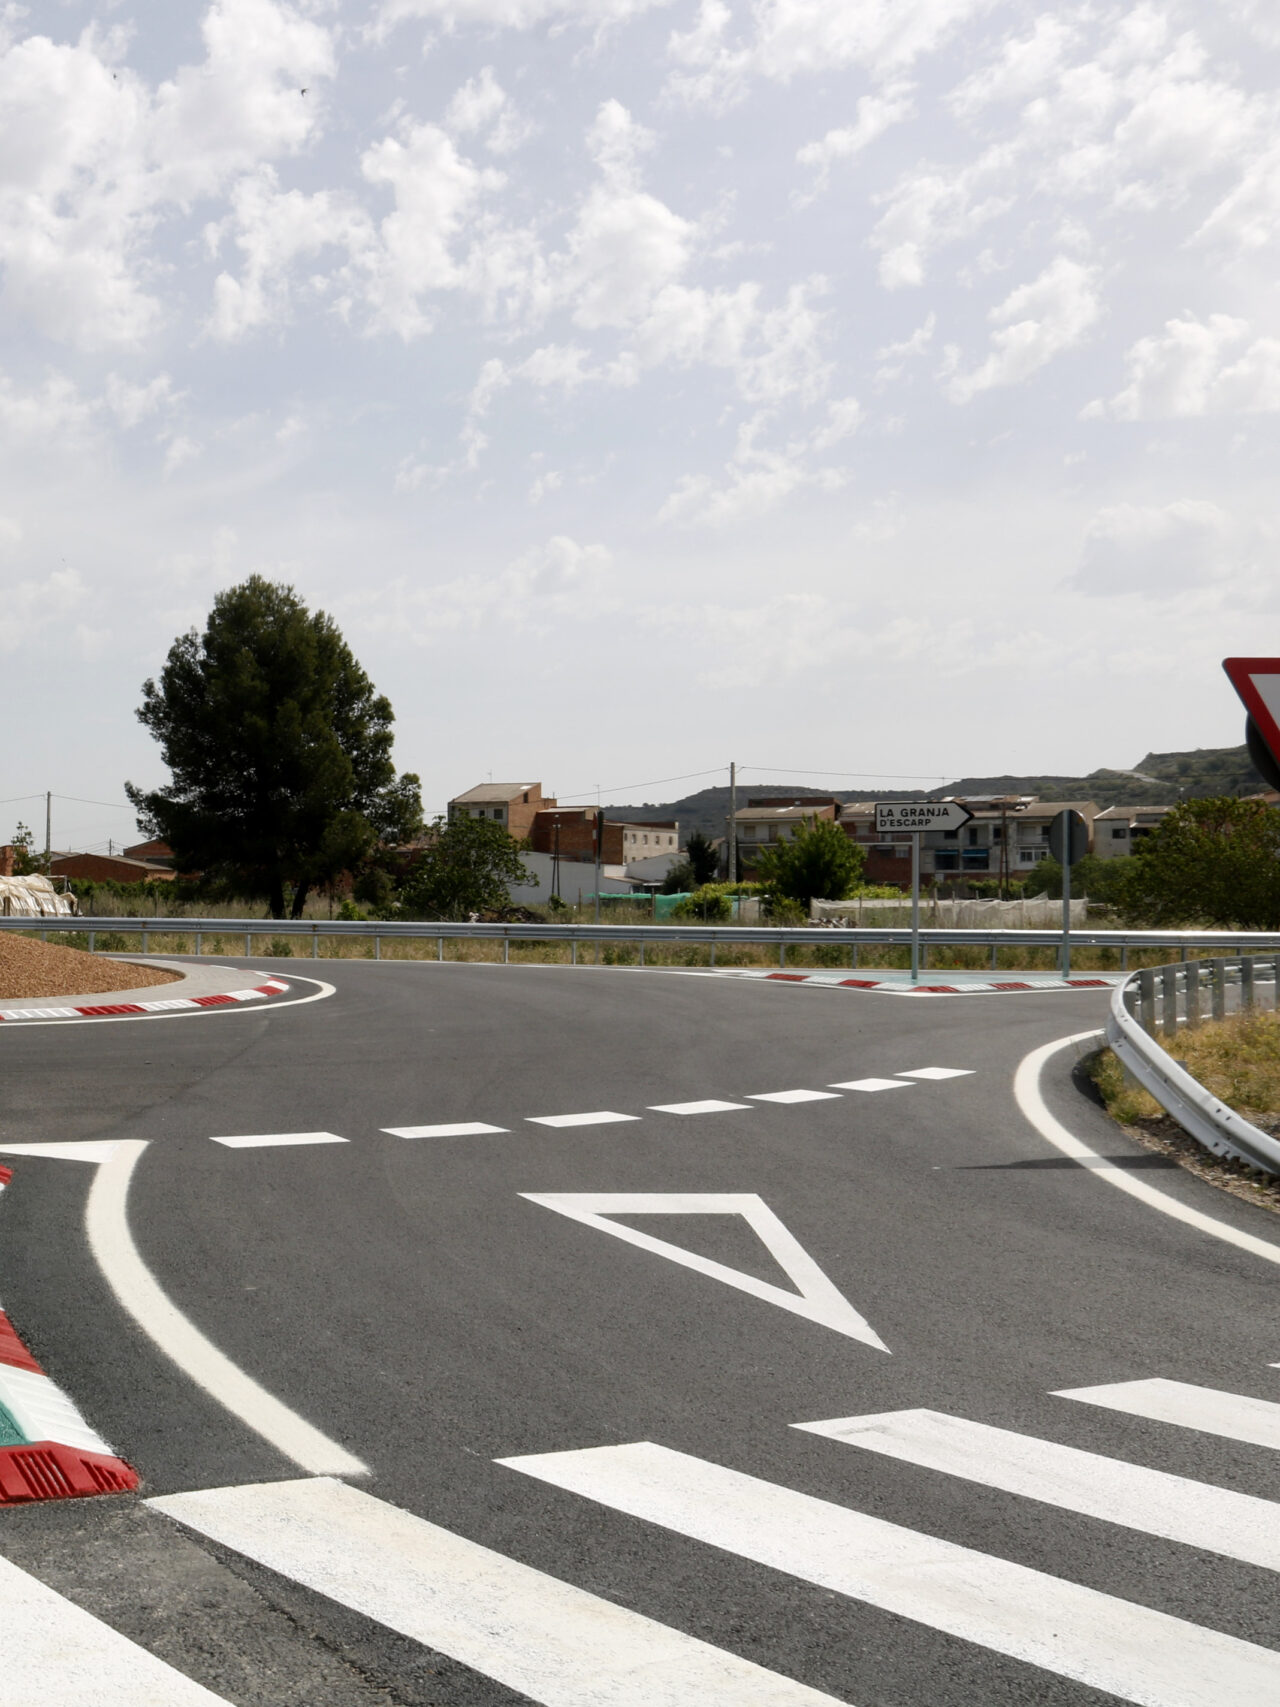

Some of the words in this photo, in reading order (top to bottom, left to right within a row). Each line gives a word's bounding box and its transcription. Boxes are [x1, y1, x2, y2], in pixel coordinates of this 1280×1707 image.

[880, 808, 894, 817] LA
[900, 808, 949, 817] GRANJA
[880, 818, 931, 827] D'ESCARP
